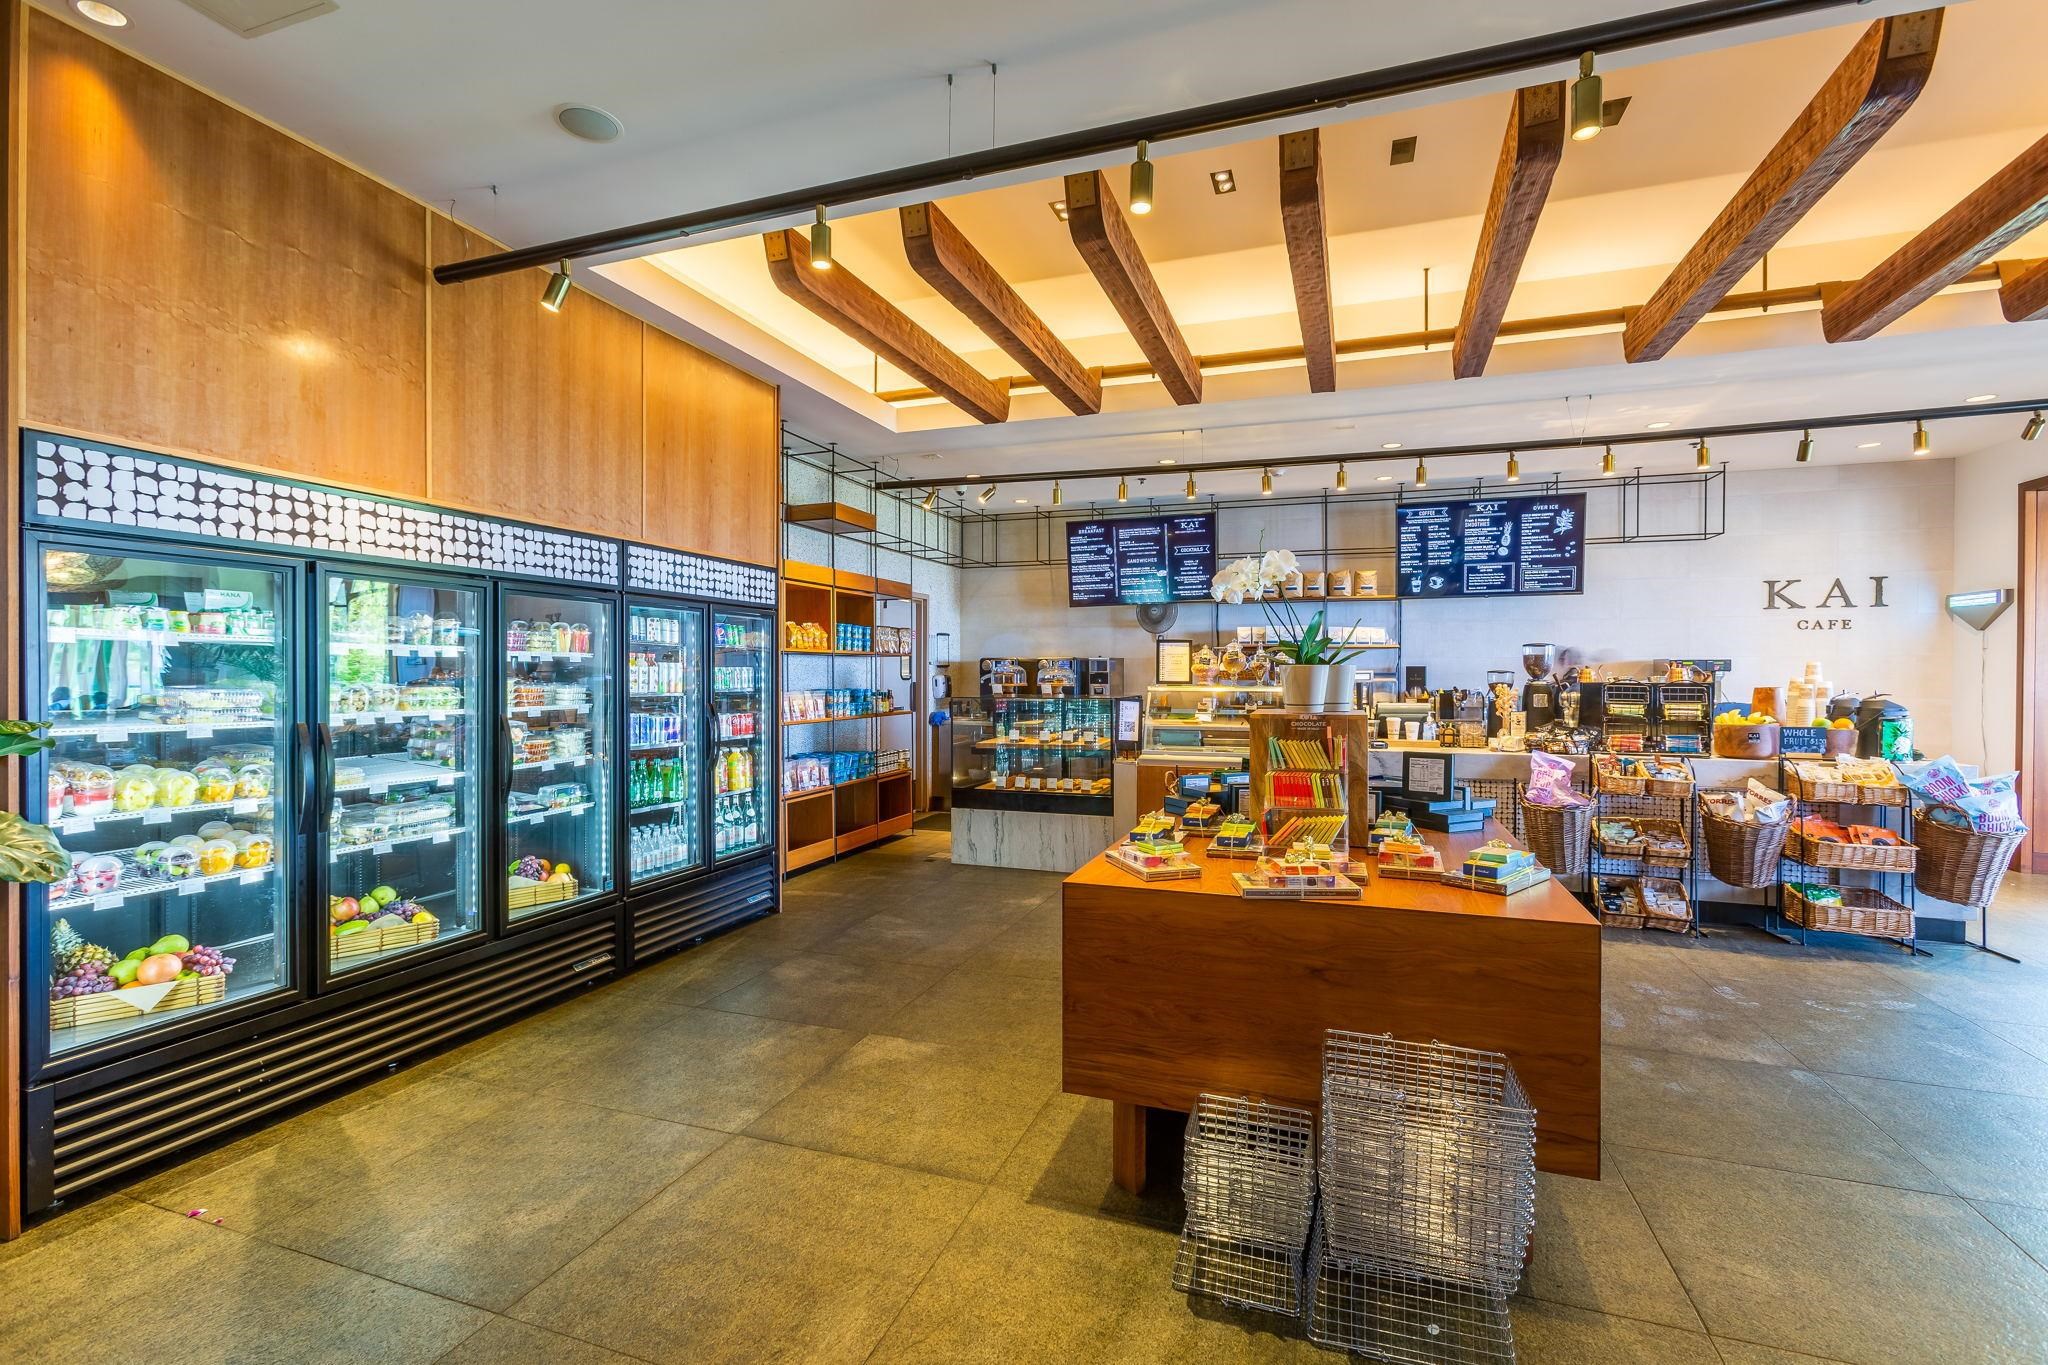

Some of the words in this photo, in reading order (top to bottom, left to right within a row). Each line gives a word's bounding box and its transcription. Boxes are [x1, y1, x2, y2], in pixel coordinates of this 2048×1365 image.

[1762, 576, 1888, 610] KAI
[1797, 620, 1852, 630] CAFE
[1783, 729, 1816, 737] WHOLE
[1923, 776, 1956, 795] BOOM
[1747, 788, 1772, 804] TORRES
